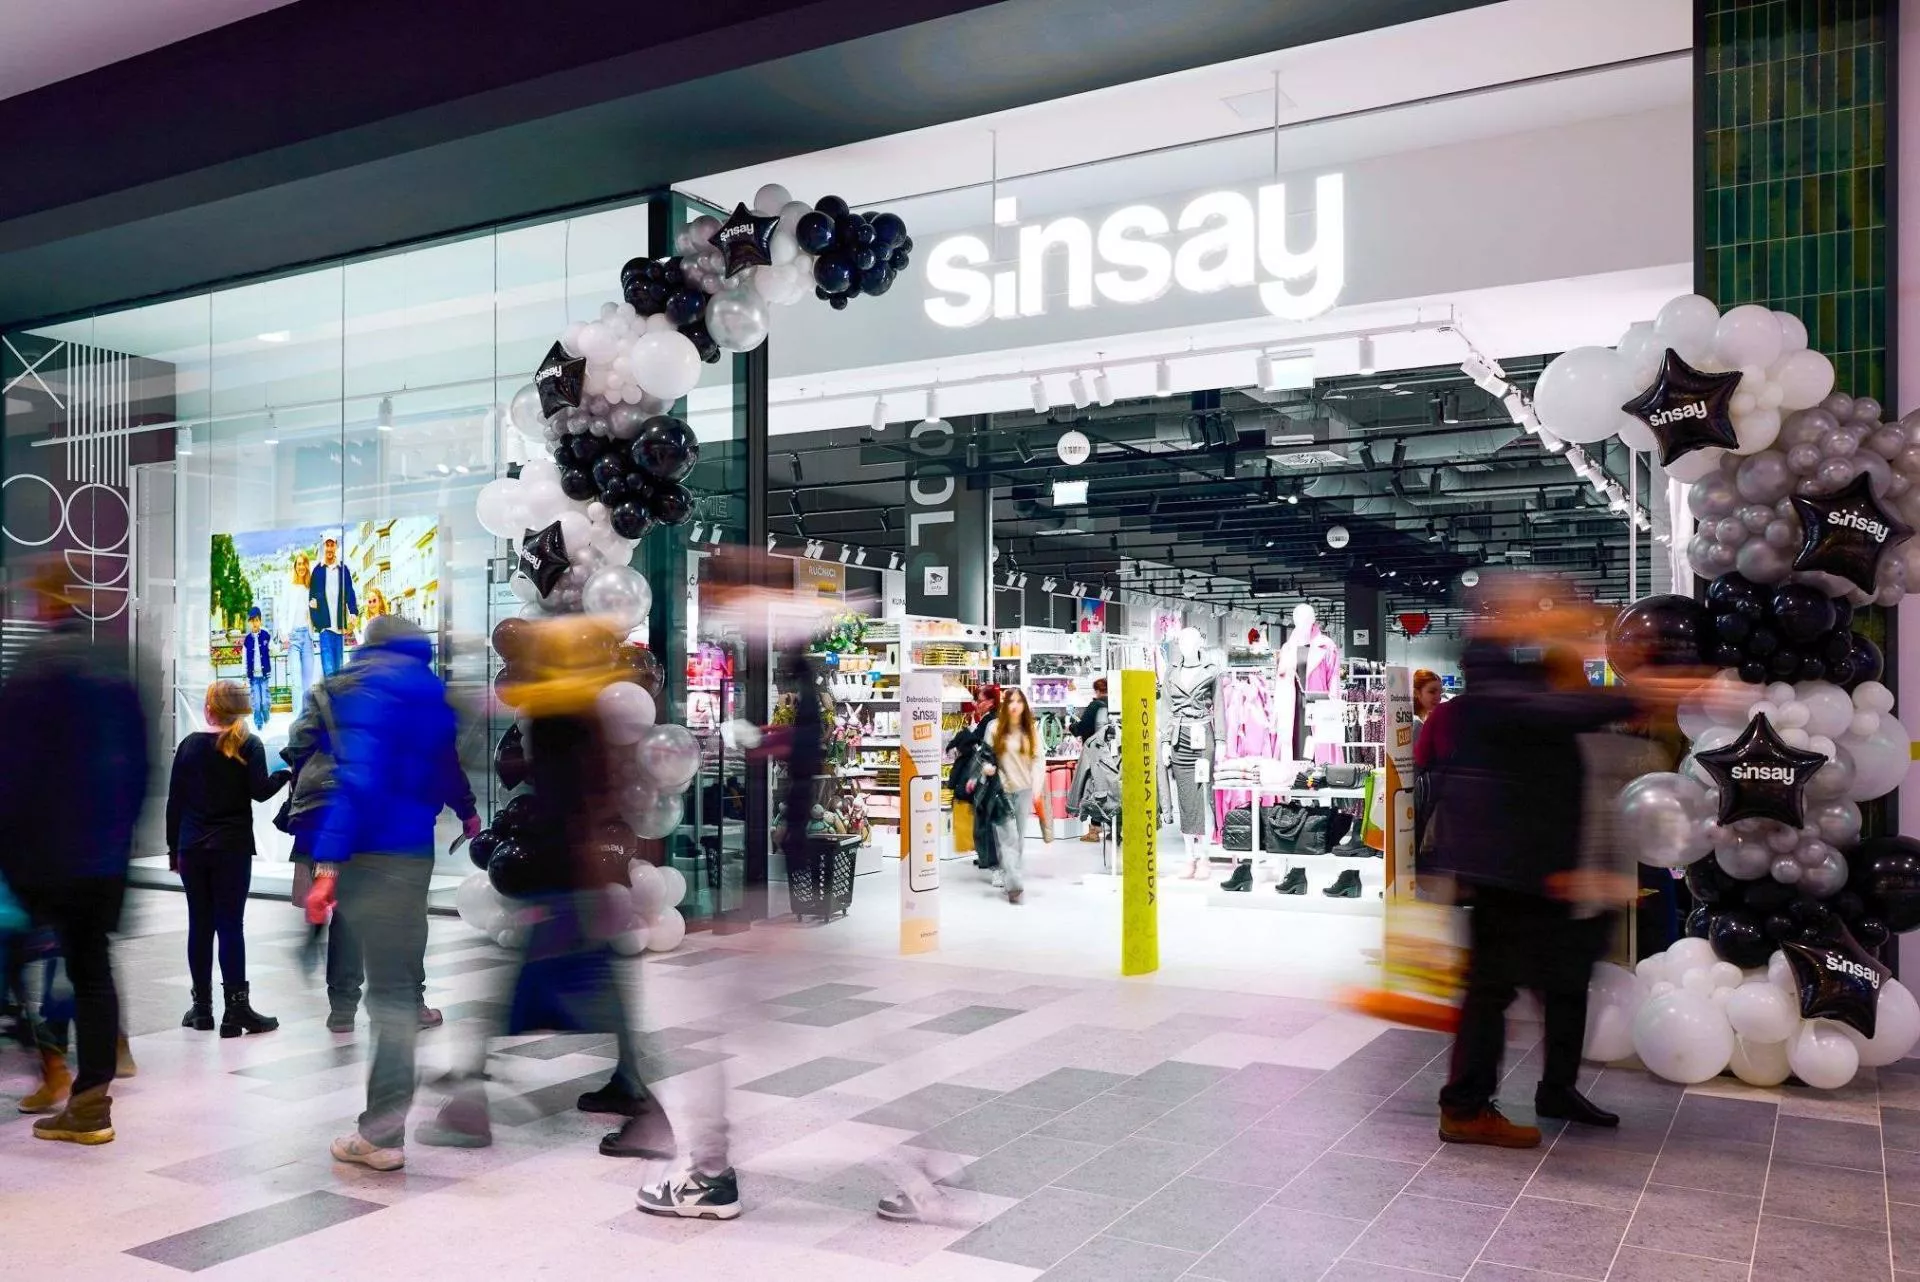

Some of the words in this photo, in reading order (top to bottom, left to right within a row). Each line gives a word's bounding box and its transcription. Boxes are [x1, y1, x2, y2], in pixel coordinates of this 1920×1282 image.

[720, 223, 755, 242] sinsay
[924, 173, 1344, 323] sinsay
[1649, 400, 1708, 427] sinsay
[1827, 508, 1890, 543] sinsay
[912, 706, 938, 724] sinsay
[1141, 697, 1152, 801] POSEBNA
[1731, 762, 1795, 785] sinsay
[1145, 810, 1155, 906] PONUDA
[1825, 954, 1880, 989] sinsay
